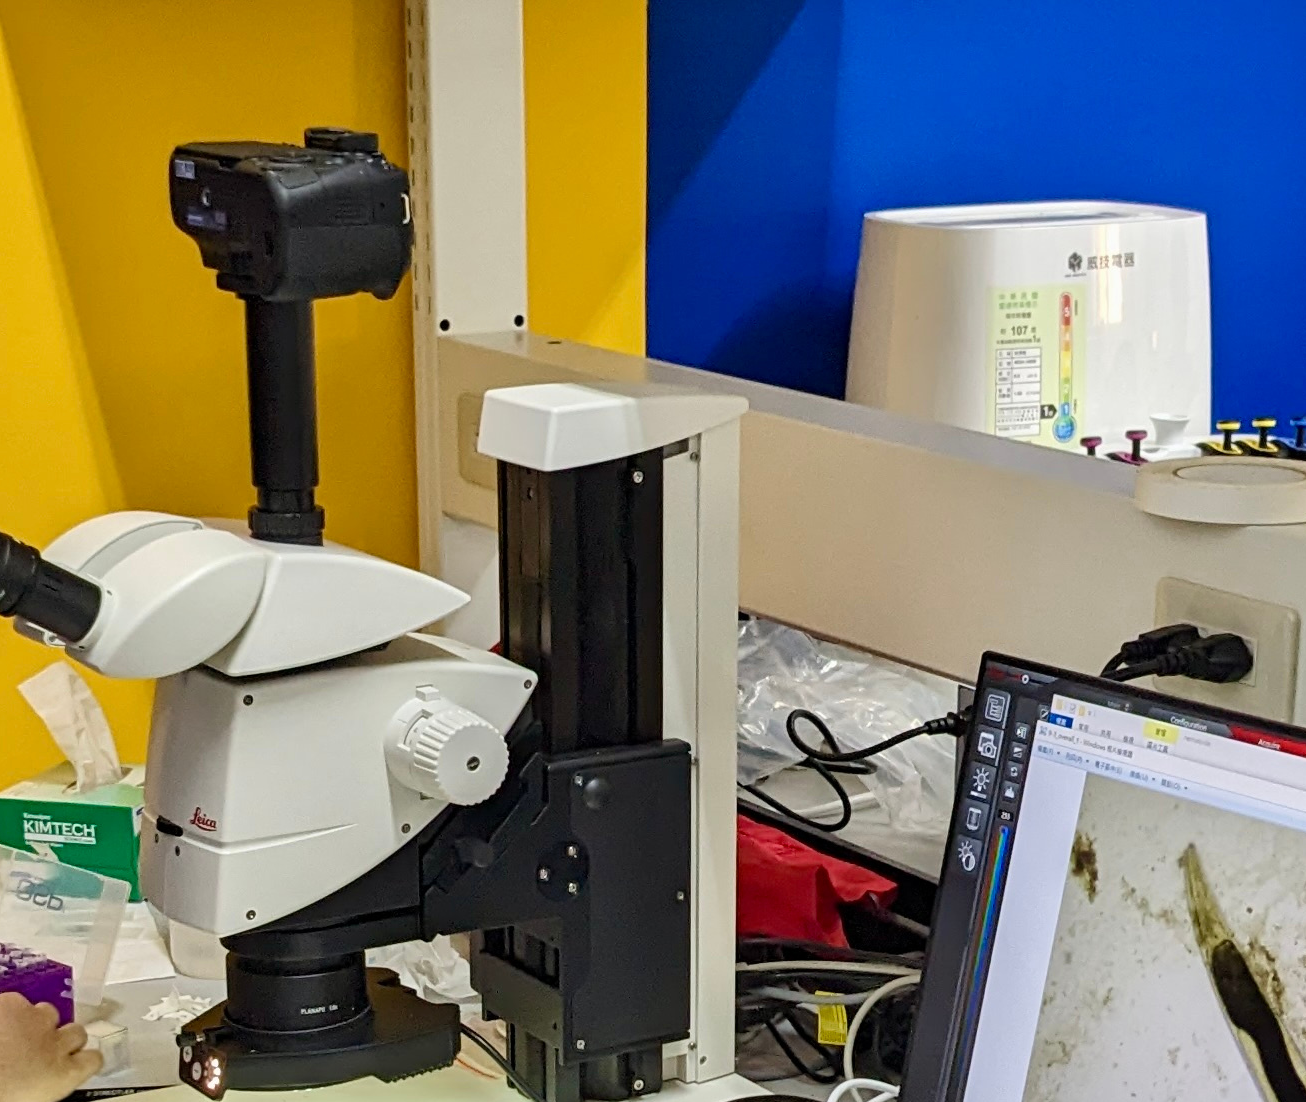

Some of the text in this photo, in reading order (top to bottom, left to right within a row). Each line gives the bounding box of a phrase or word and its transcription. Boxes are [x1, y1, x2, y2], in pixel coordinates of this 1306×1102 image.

[1170, 716, 1208, 732] Configuration
[190, 806, 217, 832] Leica
[23, 820, 96, 837] KIMTECH
